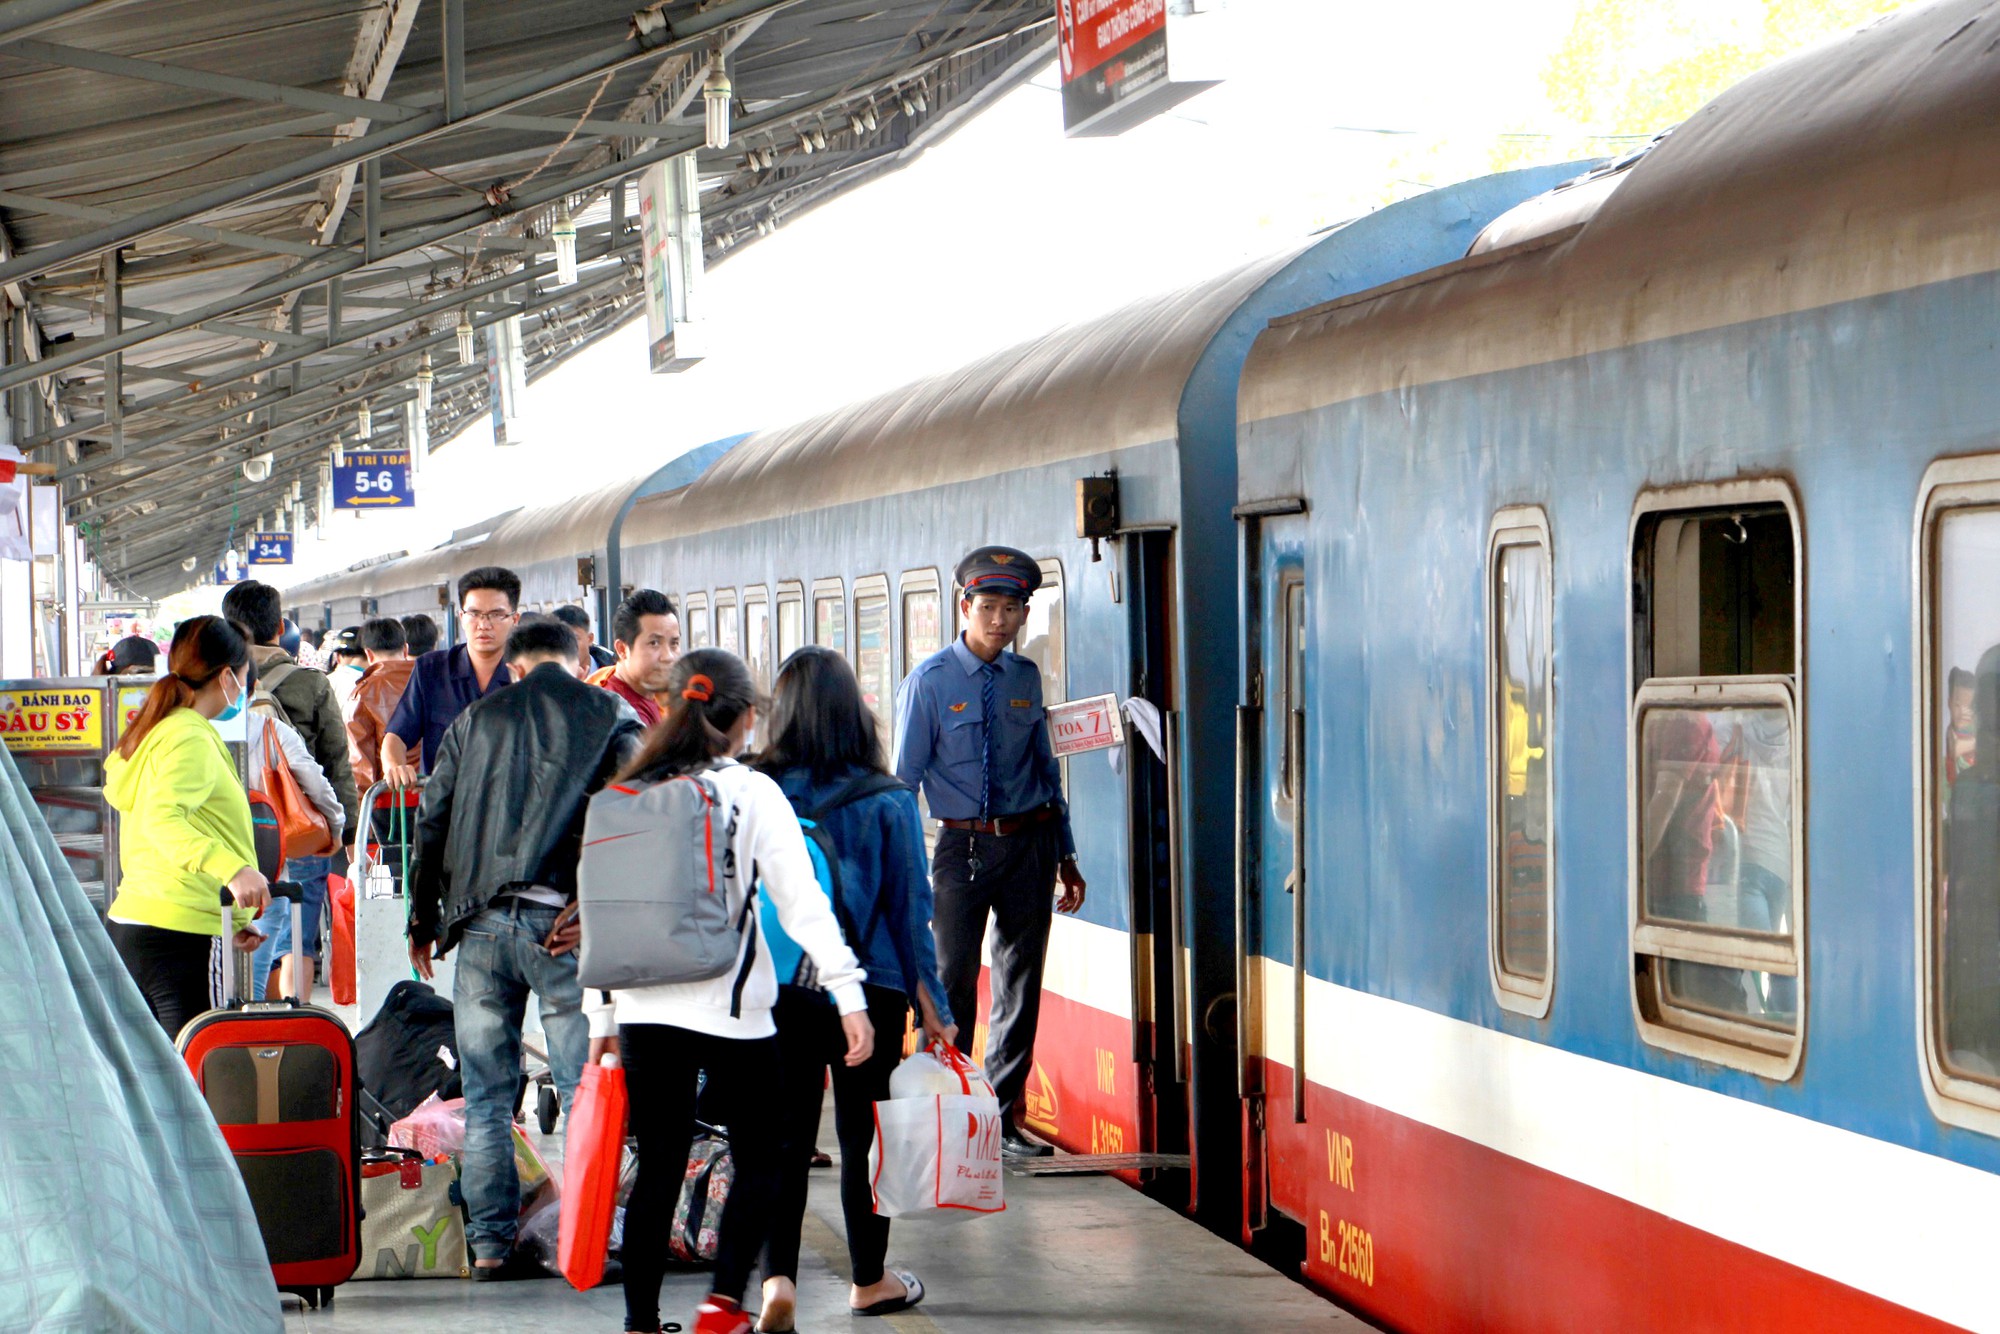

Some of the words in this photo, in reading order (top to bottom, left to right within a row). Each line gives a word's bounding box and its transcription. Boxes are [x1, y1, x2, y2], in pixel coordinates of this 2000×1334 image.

[382, 455, 406, 465] TOA
[355, 471, 393, 492] 5-6
[260, 544, 281, 556] 3-4
[22, 692, 60, 706] BÁNH
[63, 695, 91, 706] BAO
[1055, 721, 1083, 737] TOA
[1087, 711, 1101, 733] 7
[1096, 1047, 1115, 1096] VNR
[1092, 1114, 1099, 1154] A
[1326, 1128, 1354, 1193] VNR
[374, 1214, 452, 1278] NY
[1319, 1209, 1336, 1267] Bn
[1338, 1219, 1374, 1287] 21560
